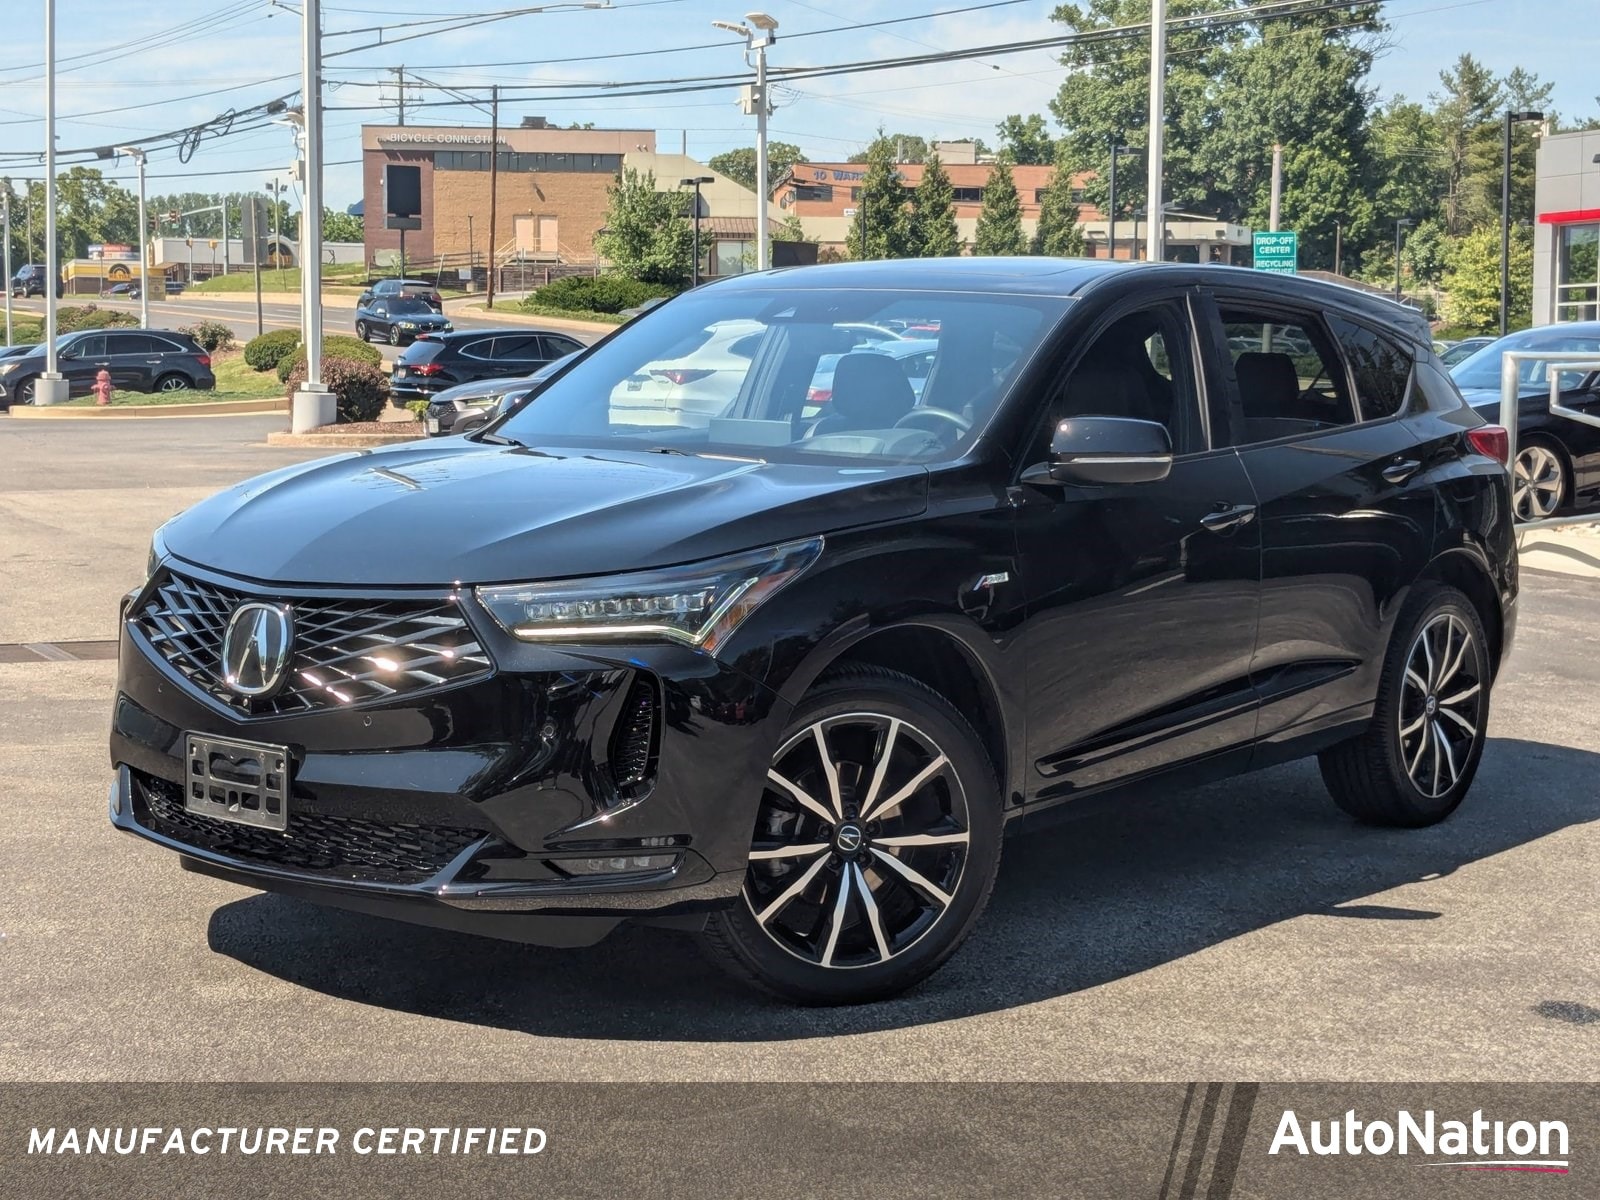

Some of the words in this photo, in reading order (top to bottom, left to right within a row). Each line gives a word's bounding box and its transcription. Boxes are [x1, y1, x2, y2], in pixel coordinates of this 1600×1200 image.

[390, 133, 434, 143] BICYCLE
[1256, 236, 1294, 245] DROP-OFF
[1259, 246, 1291, 254] CENTER
[1256, 260, 1294, 268] RECYCLING
